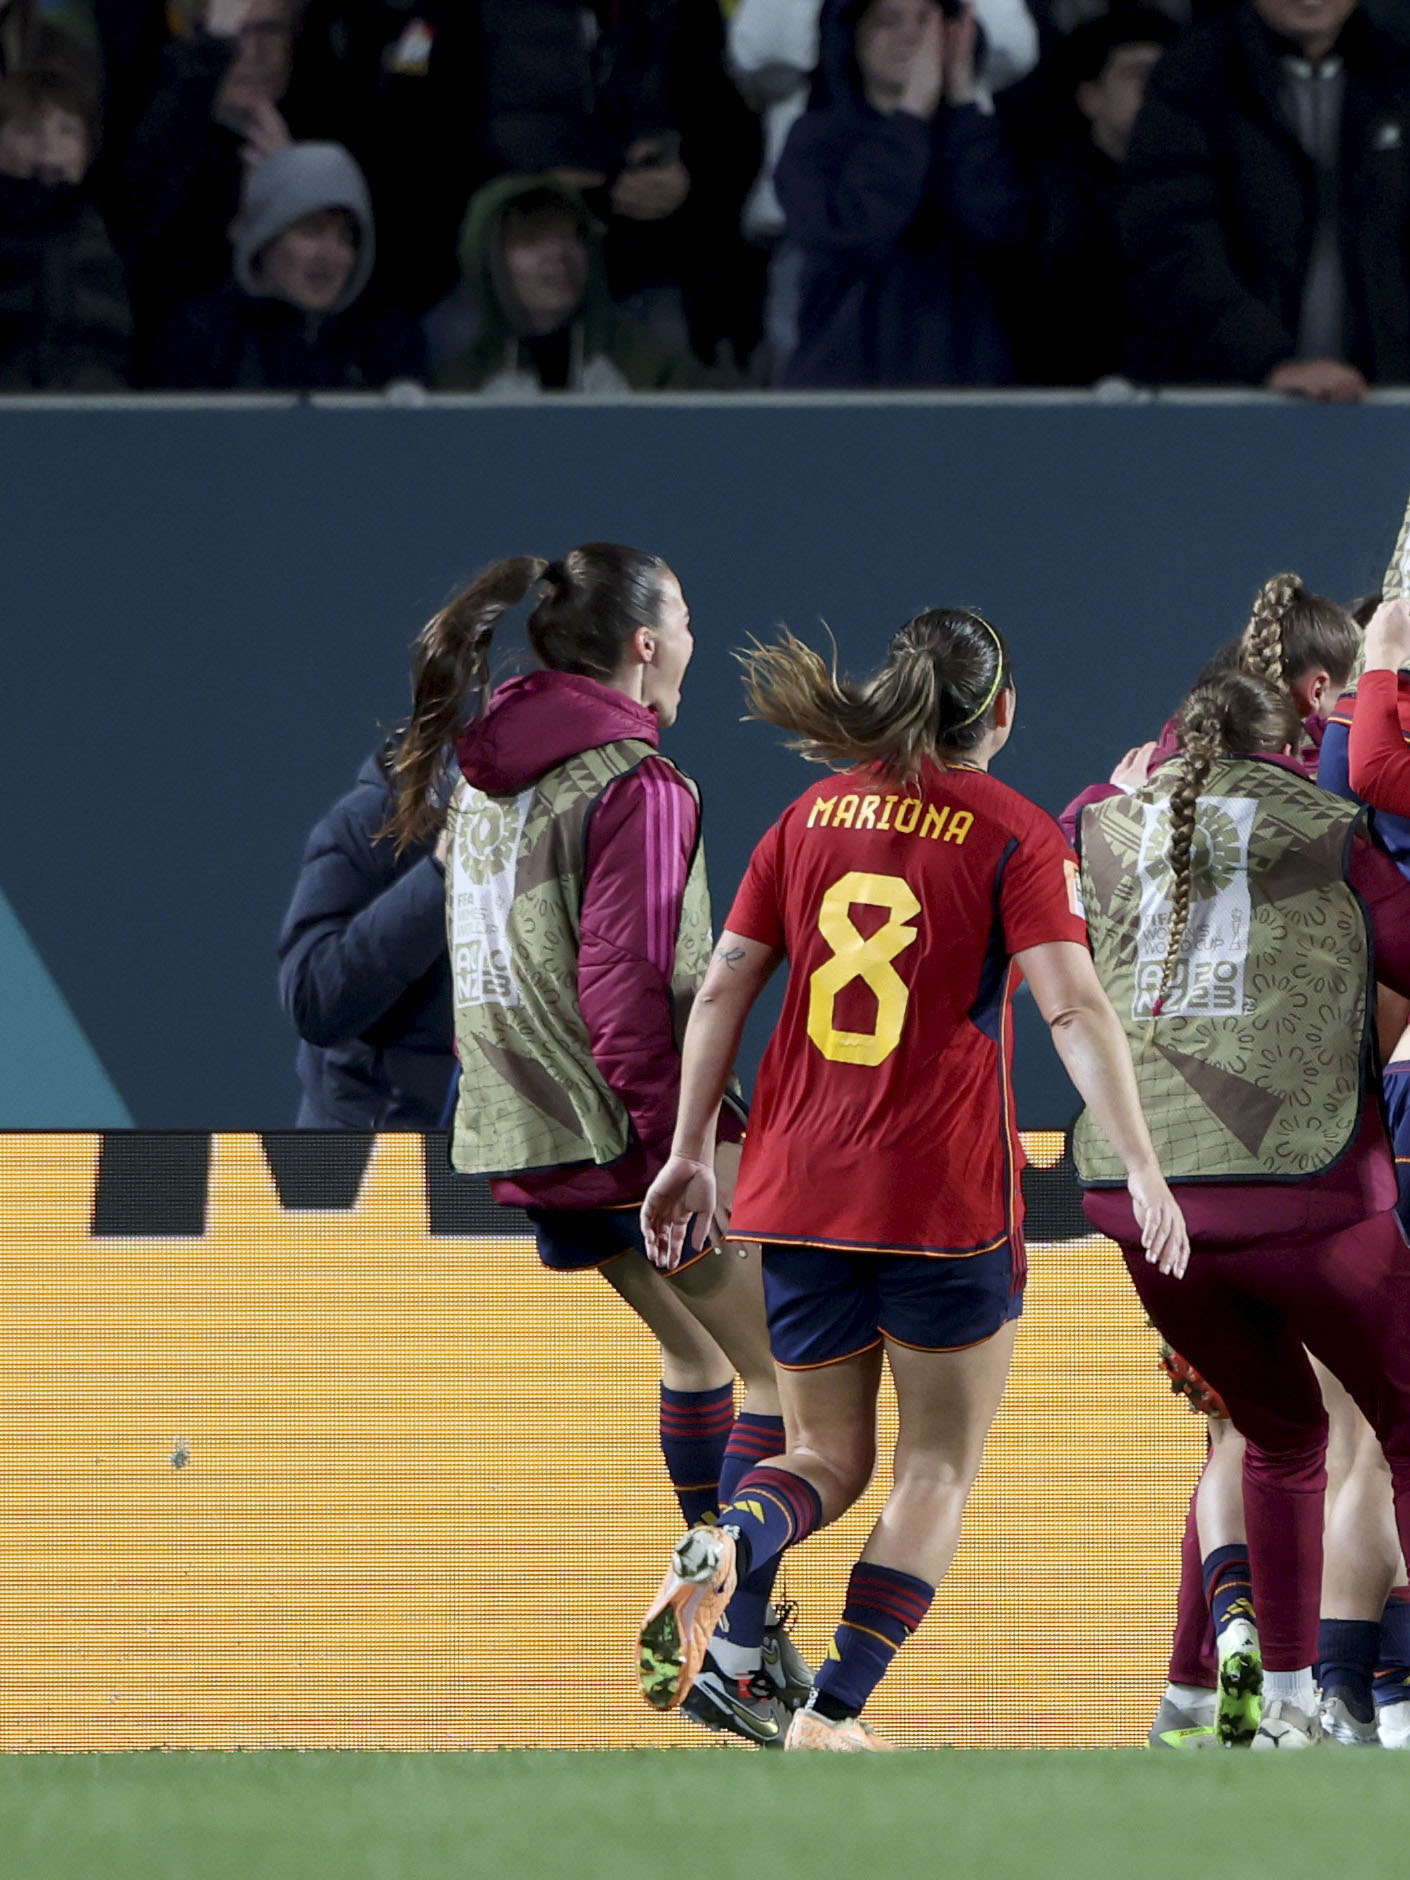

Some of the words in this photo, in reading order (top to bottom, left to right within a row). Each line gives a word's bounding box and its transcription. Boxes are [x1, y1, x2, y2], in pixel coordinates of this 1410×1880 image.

[806, 794, 974, 845] MARIONA
[806, 871, 922, 1067] 8
[1144, 940, 1192, 954] WOD
